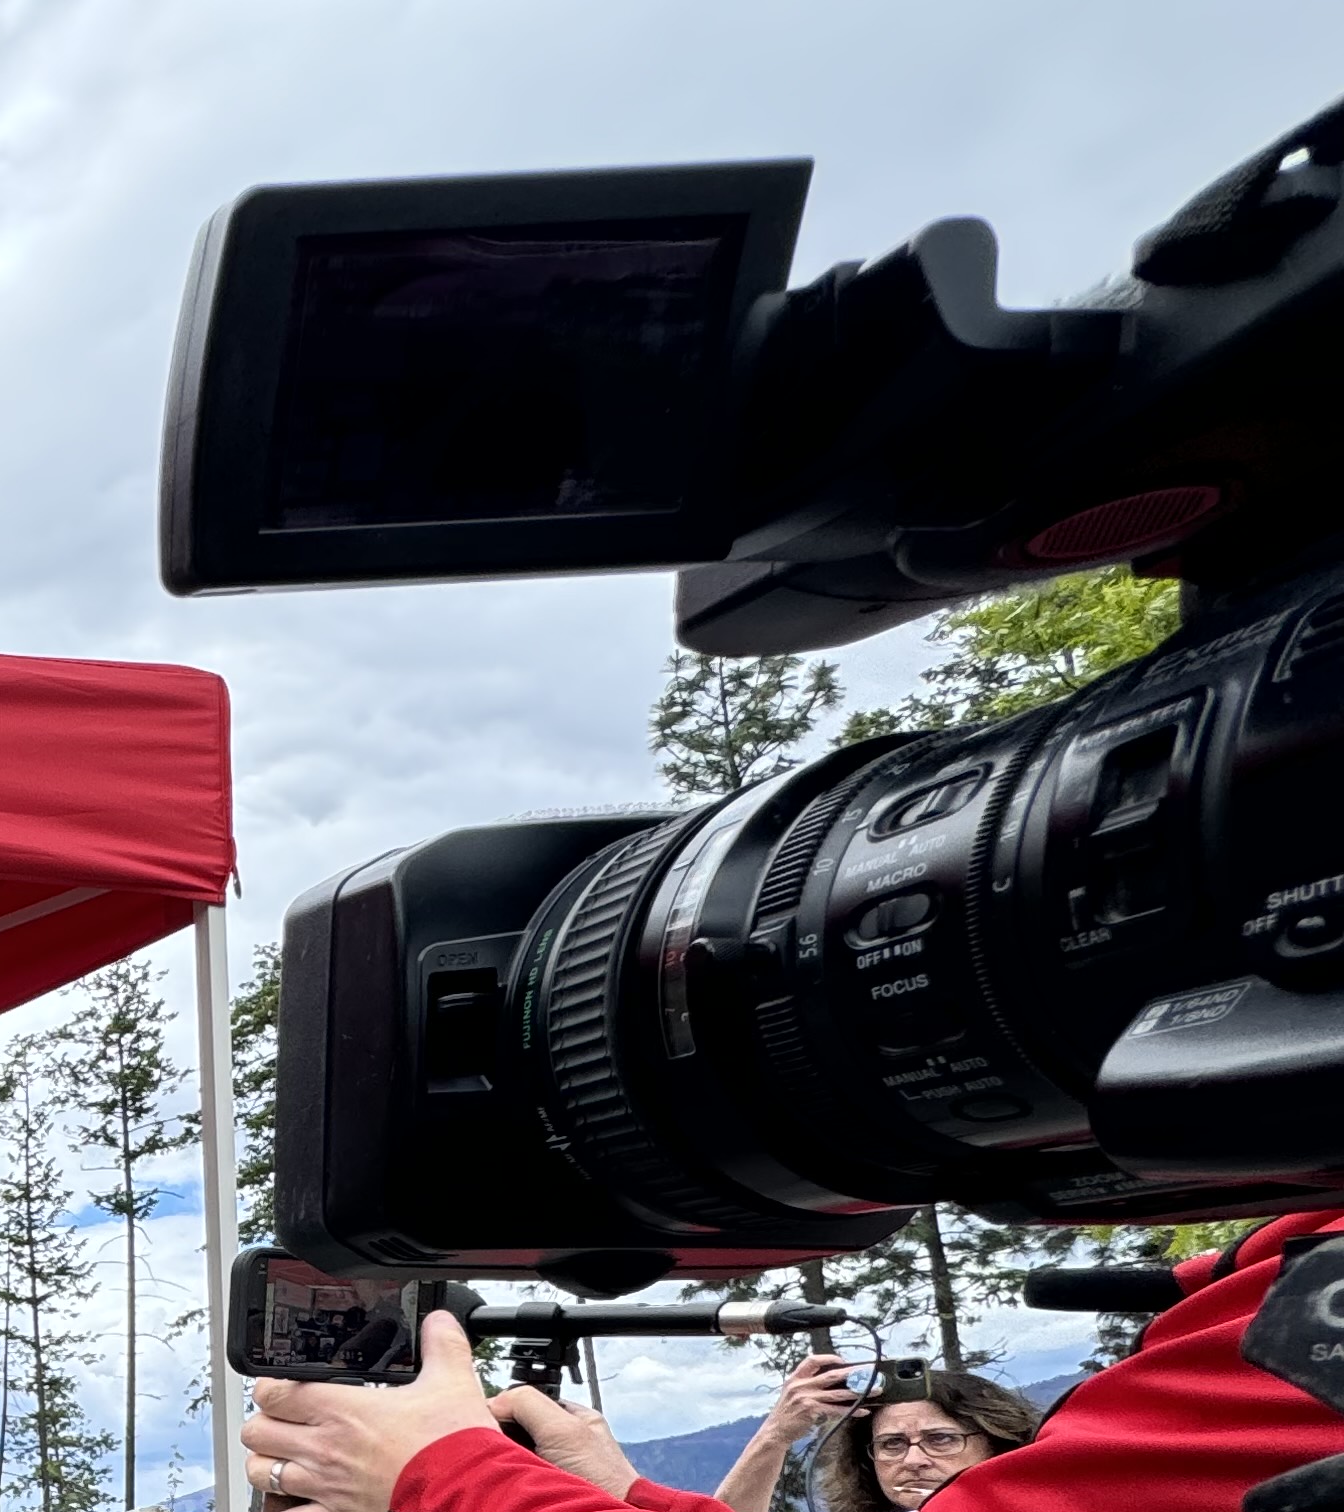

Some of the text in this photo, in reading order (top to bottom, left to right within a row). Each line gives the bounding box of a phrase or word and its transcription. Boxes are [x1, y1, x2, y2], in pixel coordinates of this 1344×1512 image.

[908, 834, 947, 857] AUTO
[813, 857, 834, 877] 10
[865, 862, 928, 893] MACRO
[1240, 912, 1280, 937] OFF
[798, 933, 818, 959] 5.6
[1059, 926, 1113, 953] CLEAR
[437, 951, 479, 967] OPEN
[856, 937, 923, 970] OFF ON
[527, 966, 539, 987] HD
[870, 972, 931, 1000] FOCUS
[522, 989, 534, 1050] FUJINON
[881, 1056, 990, 1088] MANUAL AUTO
[963, 1075, 1006, 1092] AUTO
